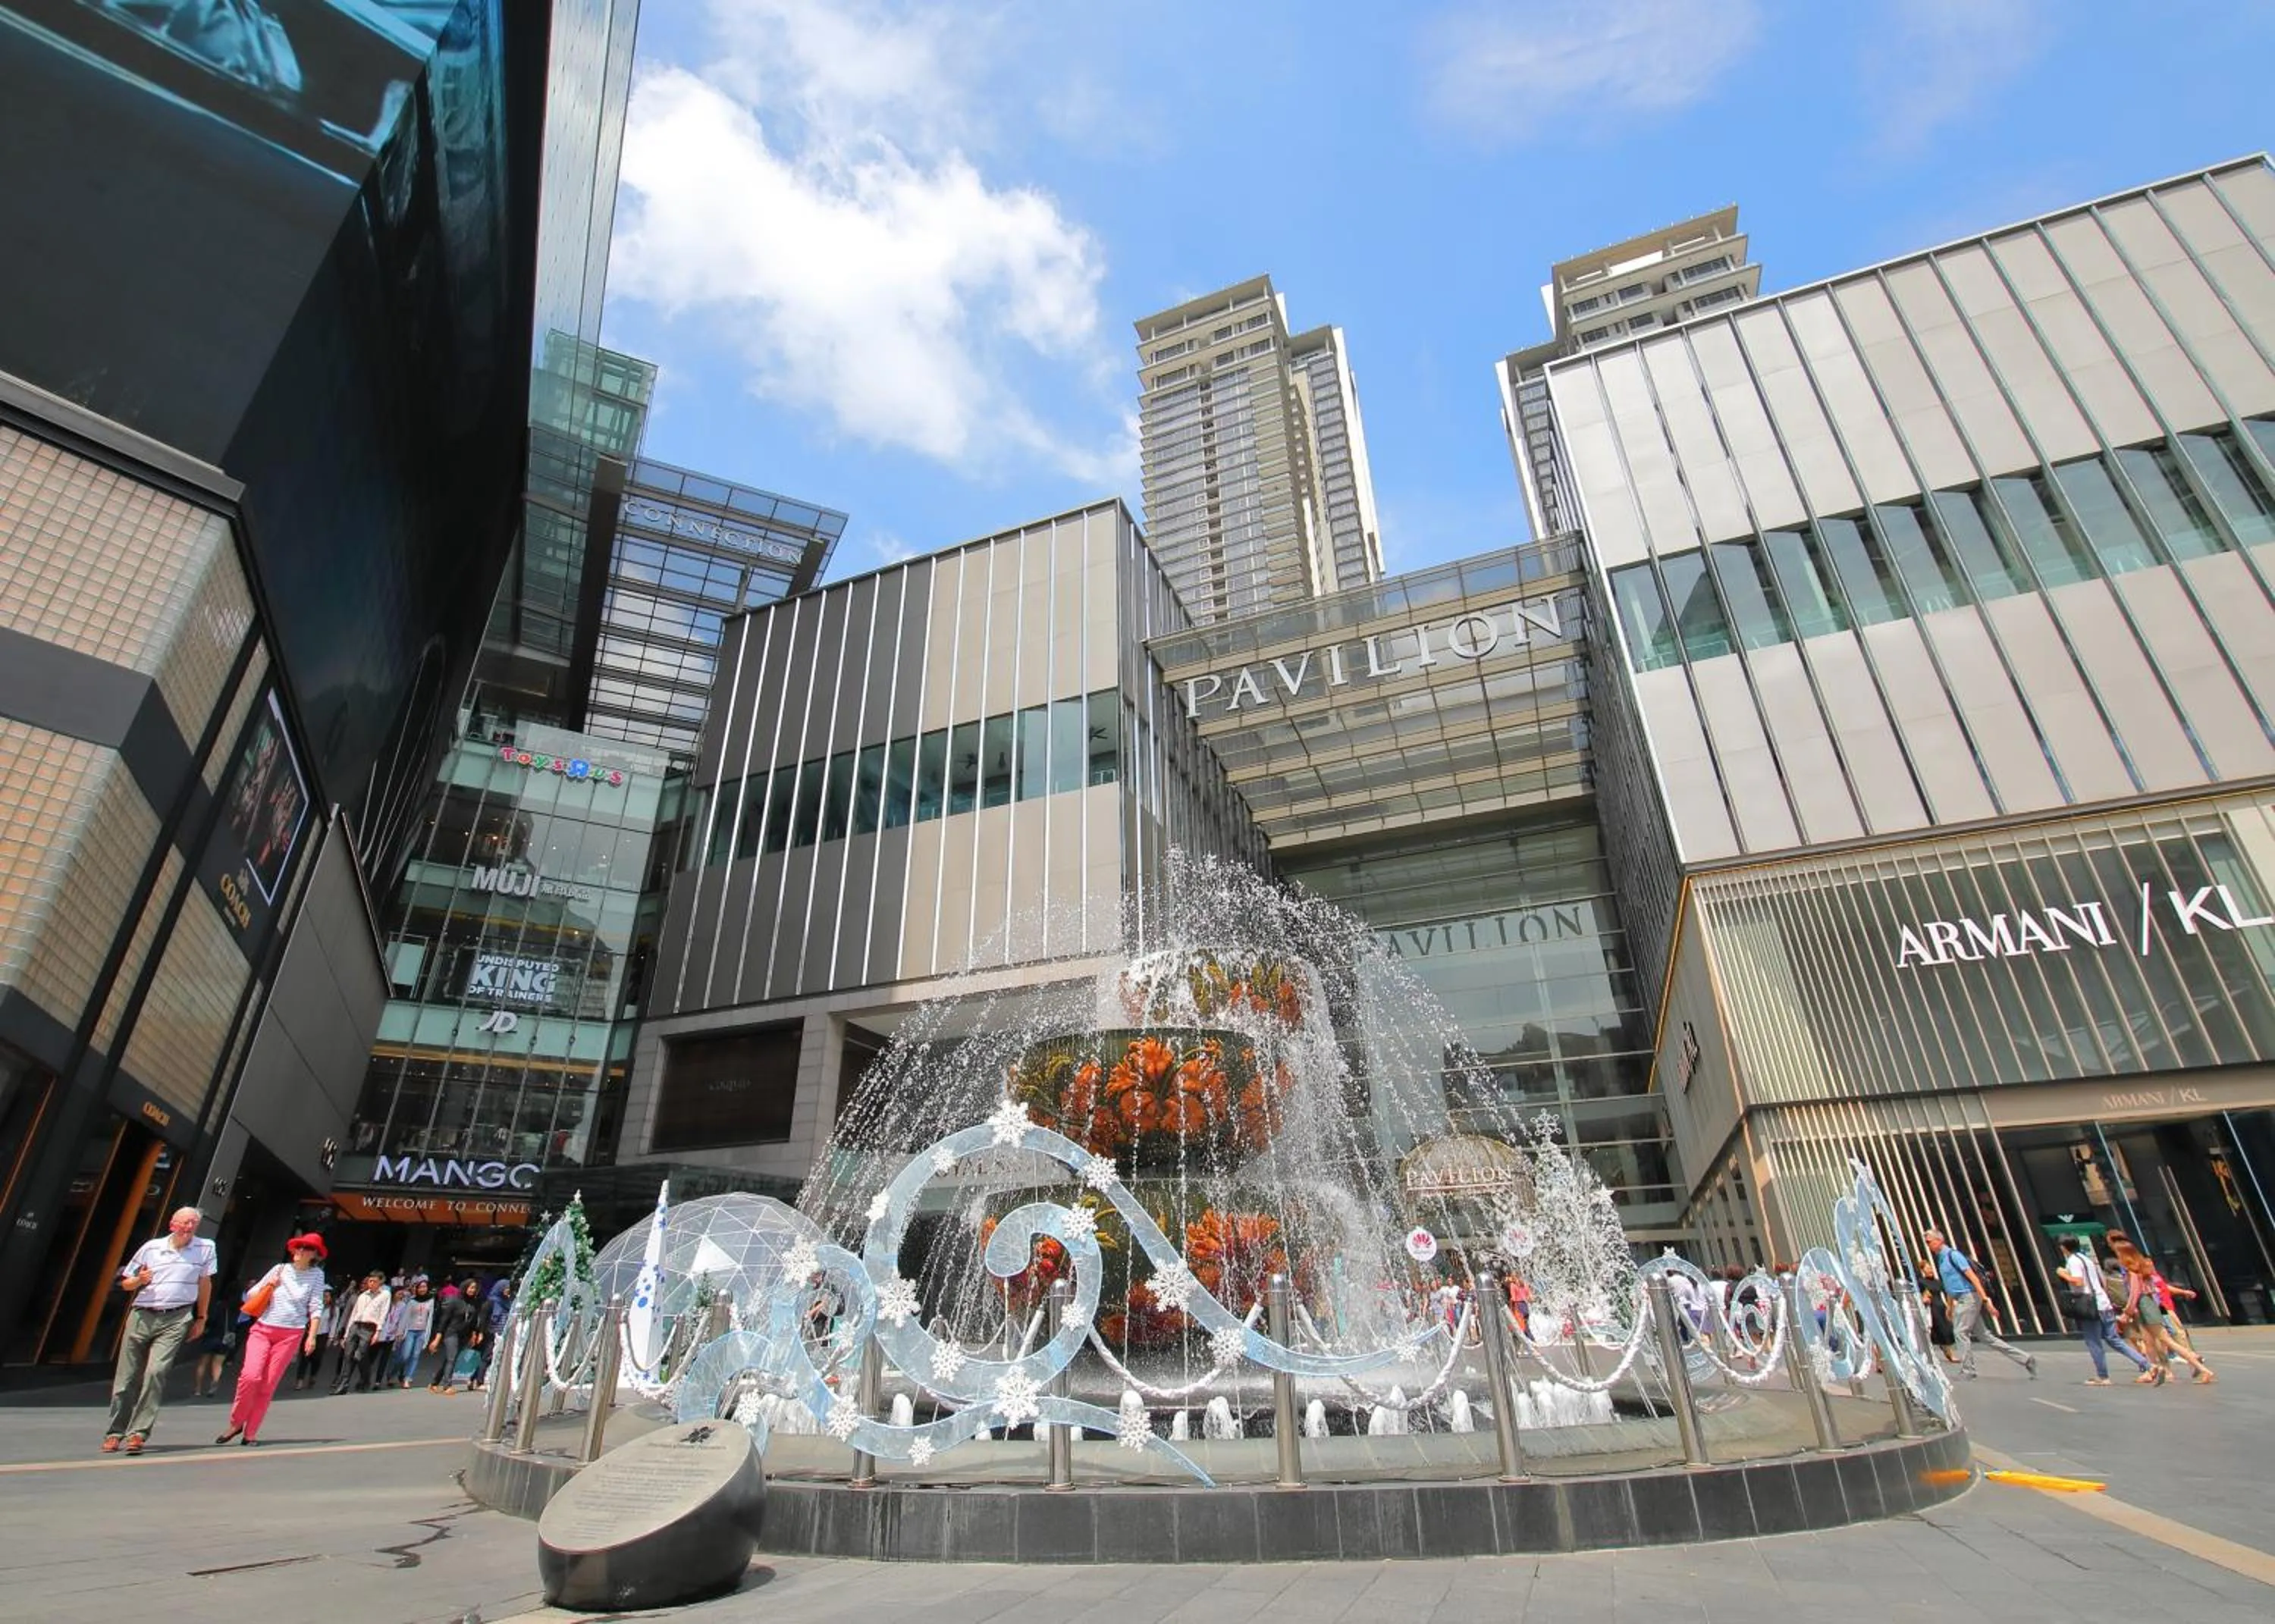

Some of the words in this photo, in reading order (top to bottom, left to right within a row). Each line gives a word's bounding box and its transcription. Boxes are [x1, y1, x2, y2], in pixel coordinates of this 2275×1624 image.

[624, 500, 805, 566] CONNECTION
[1185, 594, 1563, 719] PAVILION
[471, 865, 541, 898] MUJI
[1896, 901, 2117, 969] ARMANI
[2167, 884, 2275, 936] KL
[477, 955, 560, 973] UNDISPUTED
[467, 986, 485, 995] OF
[471, 964, 557, 994] KING
[479, 1011, 519, 1033] JD
[1406, 1164, 1513, 1187] PAVILION
[362, 1196, 438, 1211] WELCOME
[447, 1199, 466, 1214] TO
